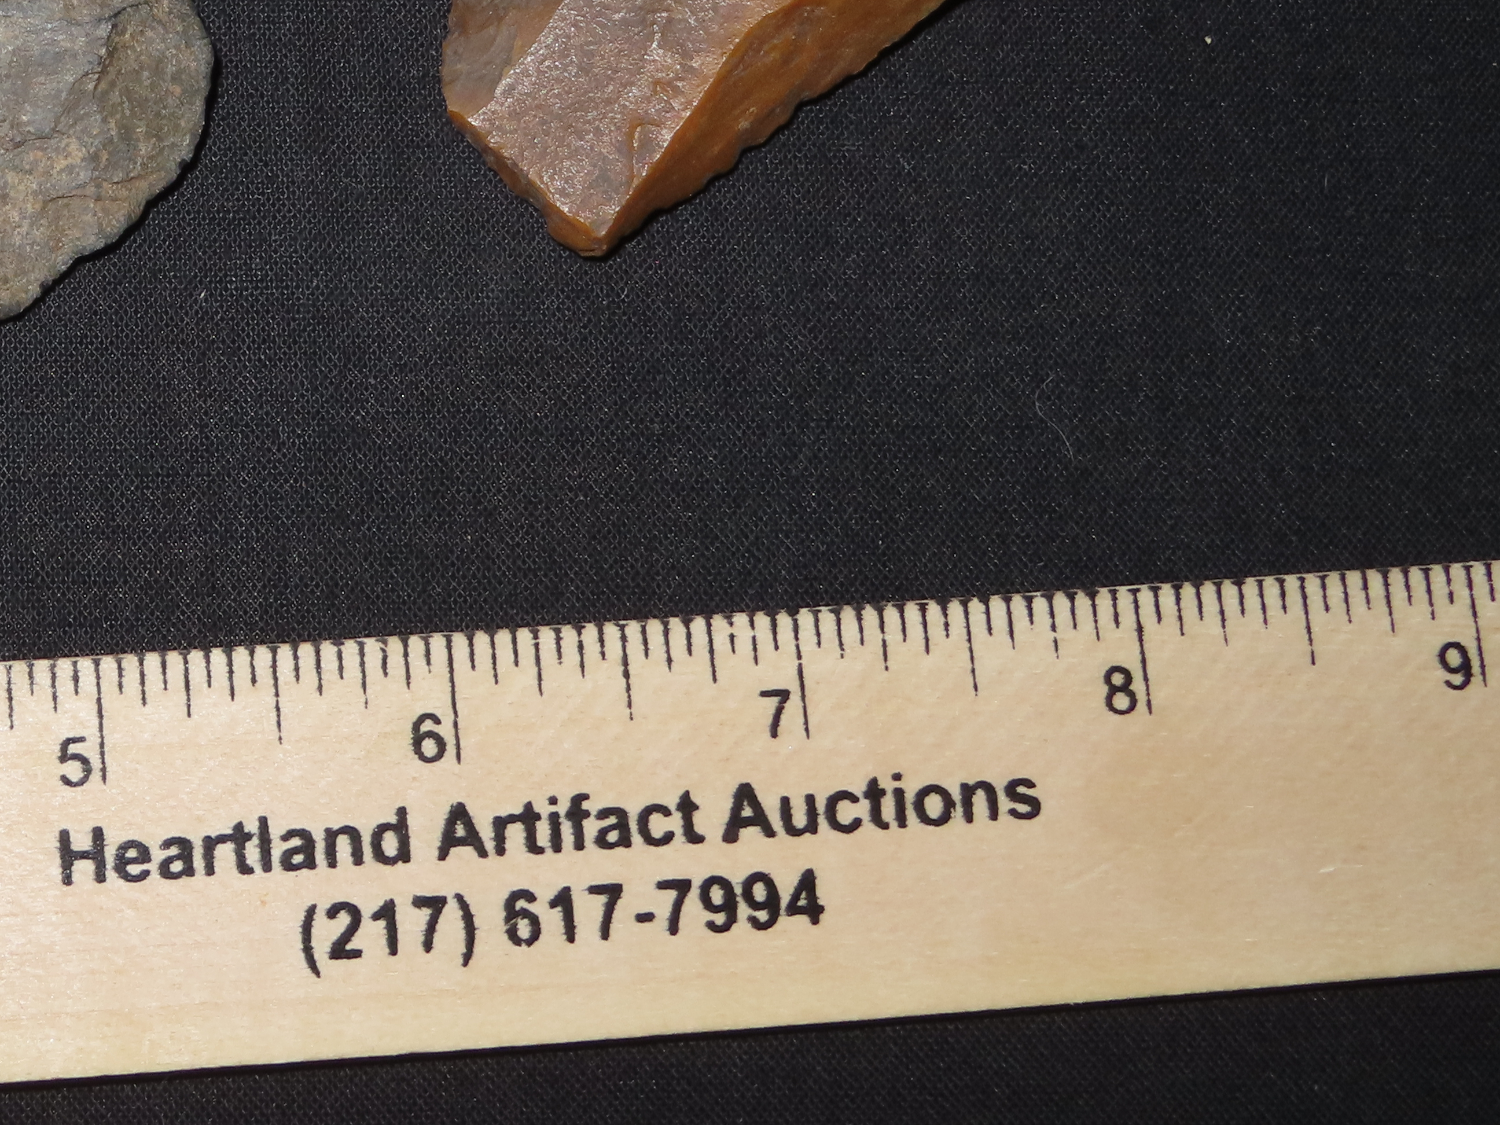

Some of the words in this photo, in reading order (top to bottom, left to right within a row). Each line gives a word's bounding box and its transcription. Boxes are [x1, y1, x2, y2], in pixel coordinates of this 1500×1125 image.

[58, 737, 92, 787] 5
[411, 713, 446, 763] 6
[759, 689, 791, 739] 7
[1104, 666, 1138, 715] 8
[1436, 641, 1474, 691] 9
[59, 806, 411, 886] Heartland
[438, 790, 705, 861] Artifact
[722, 772, 1041, 844] Auctions
[301, 893, 477, 978] (217)
[504, 868, 825, 947] 617-7994
